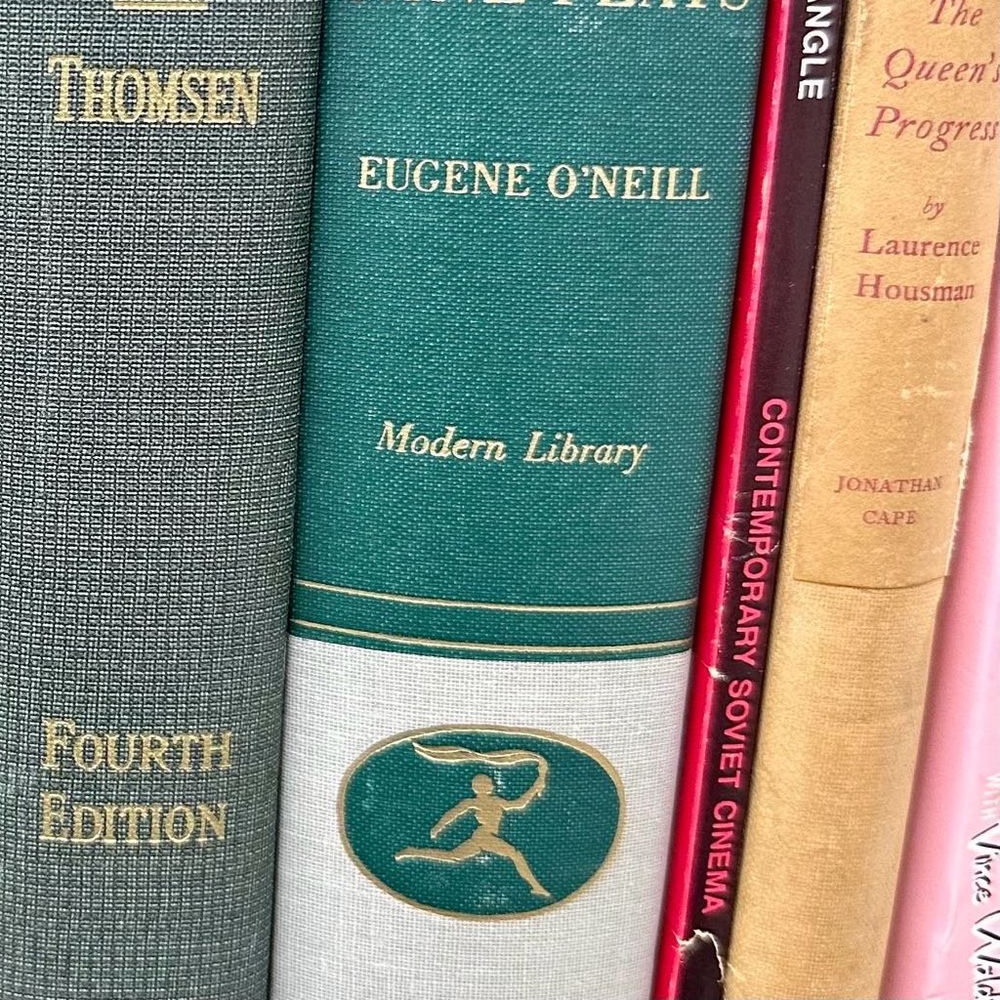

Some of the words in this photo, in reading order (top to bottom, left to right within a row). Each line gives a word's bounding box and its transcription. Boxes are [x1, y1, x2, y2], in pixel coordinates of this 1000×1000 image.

[48, 54, 262, 126] THOMSEN
[865, 105, 1000, 152] Progress
[358, 155, 531, 199] EUGENE
[547, 163, 711, 202] O'NEILL
[922, 195, 946, 221] by
[859, 228, 981, 258] Laurence
[854, 273, 976, 301] Housman
[376, 421, 507, 464] Modern
[525, 431, 649, 477] Library
[833, 475, 943, 494] JONATHAN
[729, 398, 787, 668] CONTEMPORARY
[862, 510, 918, 526] CAPE
[41, 718, 232, 773] FOURTH
[716, 679, 752, 789] SOVIET
[39, 793, 229, 846] EDITION
[700, 800, 738, 915] CINEMA
